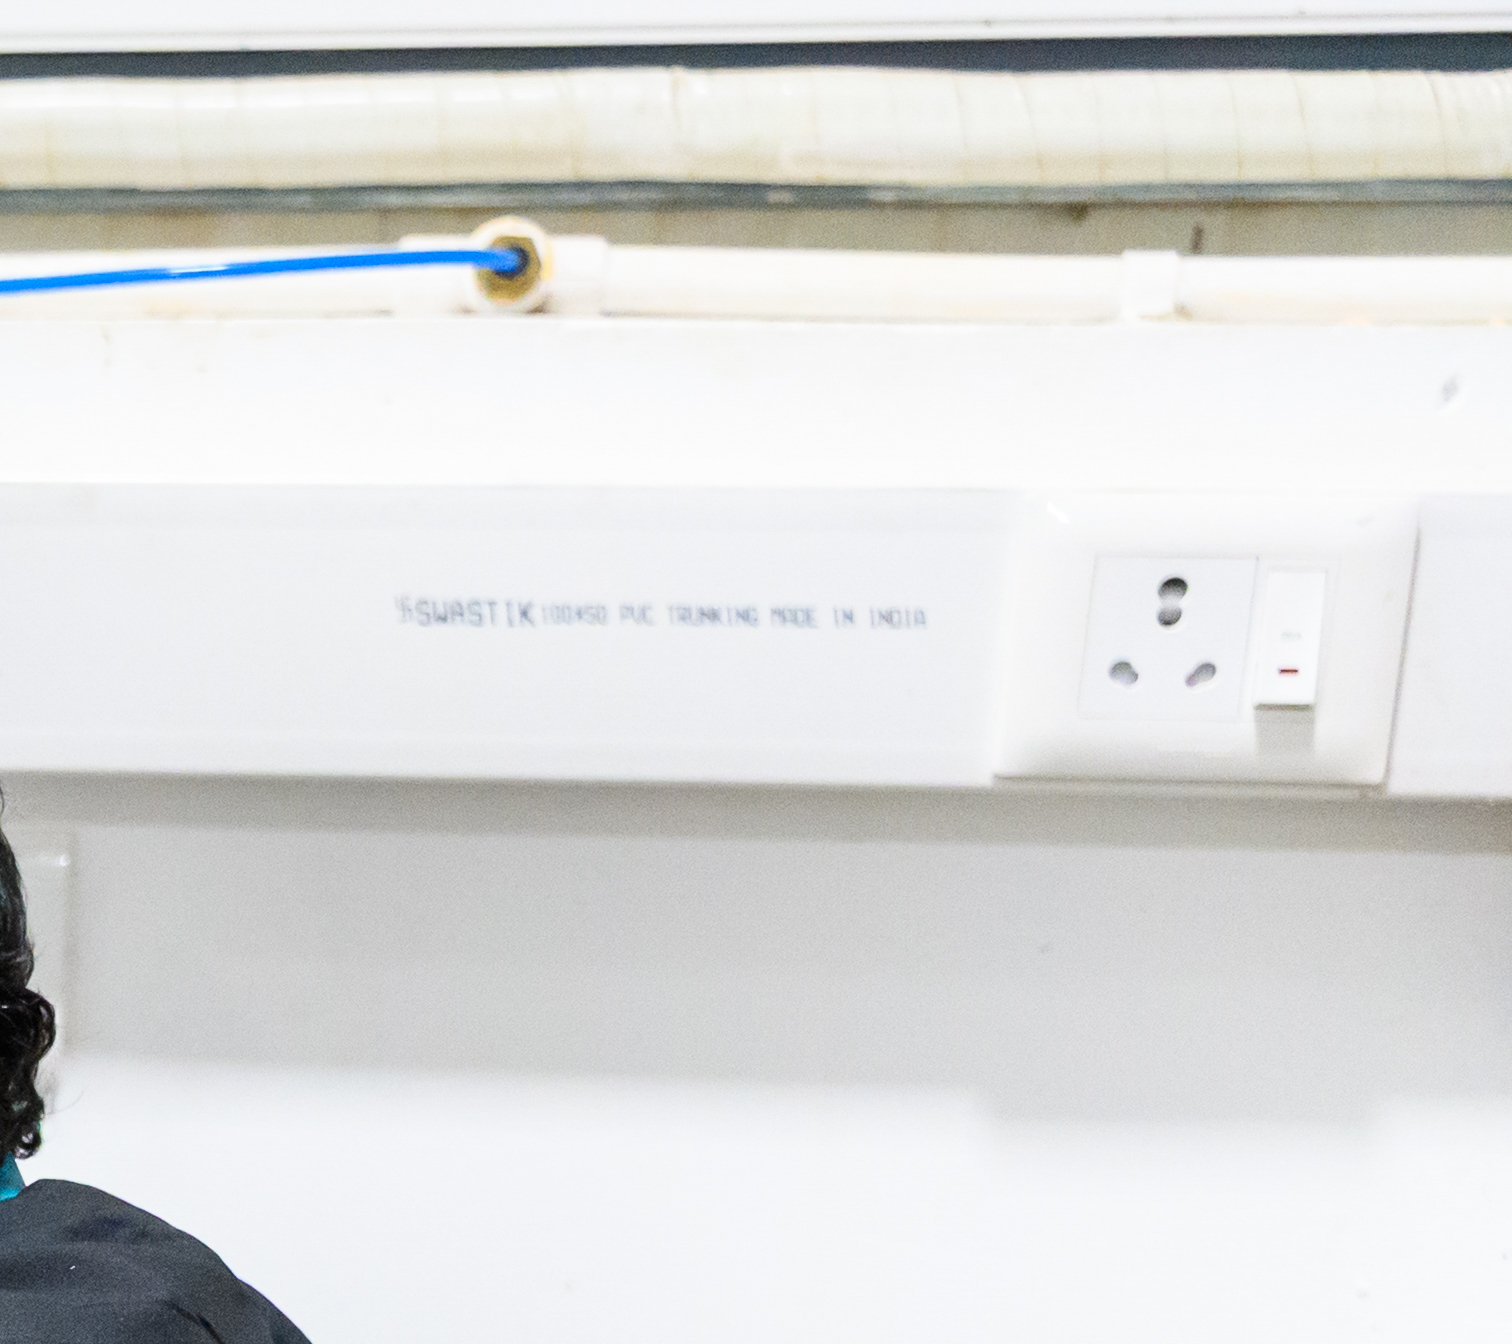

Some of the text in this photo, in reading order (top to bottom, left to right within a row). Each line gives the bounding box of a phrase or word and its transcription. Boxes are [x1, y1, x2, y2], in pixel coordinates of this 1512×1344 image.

[415, 599, 536, 628] SWASTIK
[667, 605, 759, 628] TRUNKING
[770, 606, 817, 629] MADE
[833, 606, 856, 629] IN
[870, 606, 927, 629] INDIA
